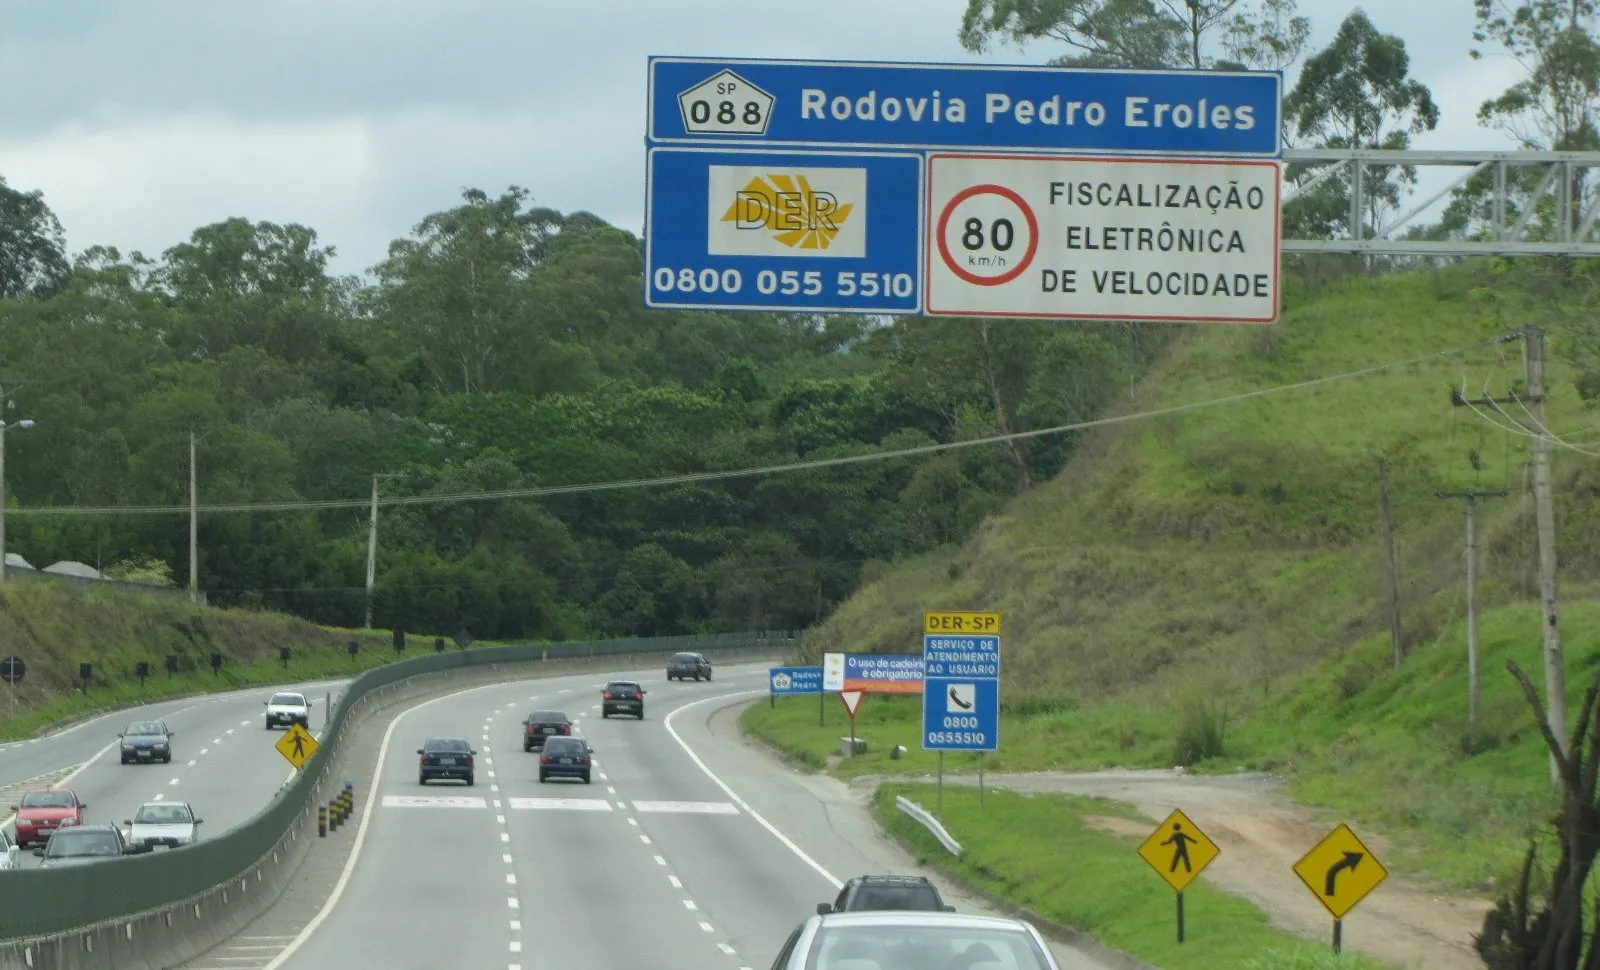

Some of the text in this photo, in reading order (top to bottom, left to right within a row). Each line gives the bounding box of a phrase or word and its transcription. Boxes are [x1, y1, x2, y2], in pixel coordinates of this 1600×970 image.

[717, 82, 737, 95] SP
[690, 100, 761, 125] 088
[801, 89, 1256, 130] Rodovia Pedro Eroles
[1049, 180, 1264, 214] FISCALIZAÇÃO
[736, 190, 839, 231] DER
[962, 217, 1014, 251] 80
[1066, 221, 1245, 253] ELETRÔNICA
[968, 255, 1006, 267] km/h
[654, 267, 912, 297] 0800 055 5510
[1041, 269, 1268, 297] DE VELOCIDADE
[929, 616, 995, 630] DER-SP
[930, 639, 994, 651] SERVIÇO DE
[848, 657, 856, 667] O
[877, 659, 889, 668] de
[927, 651, 997, 662] ATENDIMENTO
[870, 668, 922, 681] obrigatório
[928, 662, 995, 674] AO USUÁRIO
[943, 716, 977, 728] 0800
[928, 732, 985, 744] 0555510
